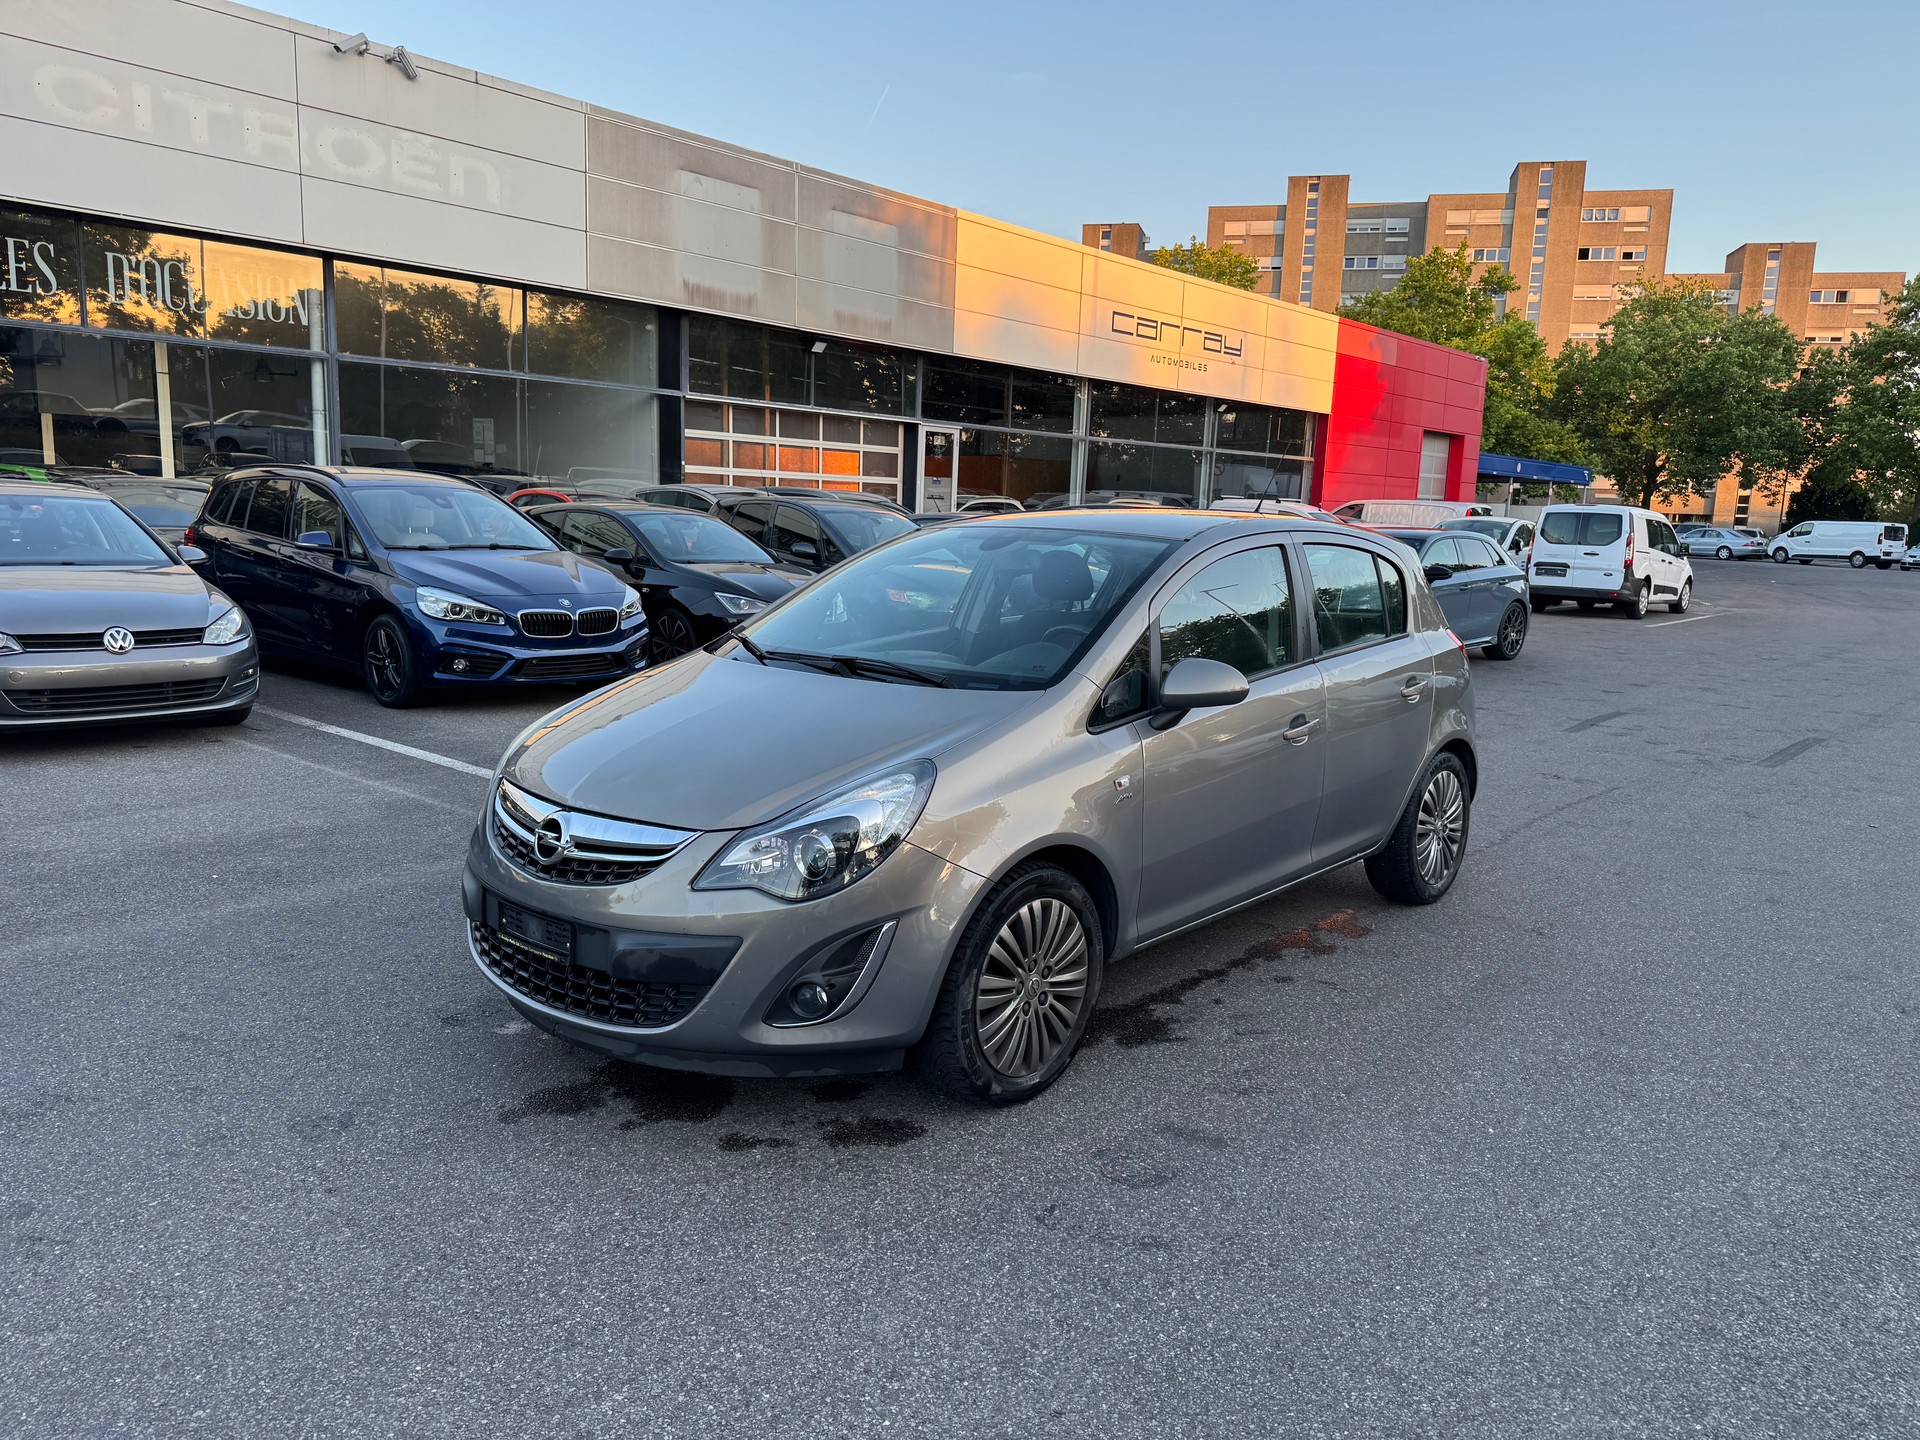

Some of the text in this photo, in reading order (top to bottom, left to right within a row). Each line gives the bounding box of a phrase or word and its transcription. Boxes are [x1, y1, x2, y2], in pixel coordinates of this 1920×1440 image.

[0, 236, 58, 296] ES
[1111, 310, 1243, 357] carray
[1150, 354, 1208, 372] AUTOMOBILES
